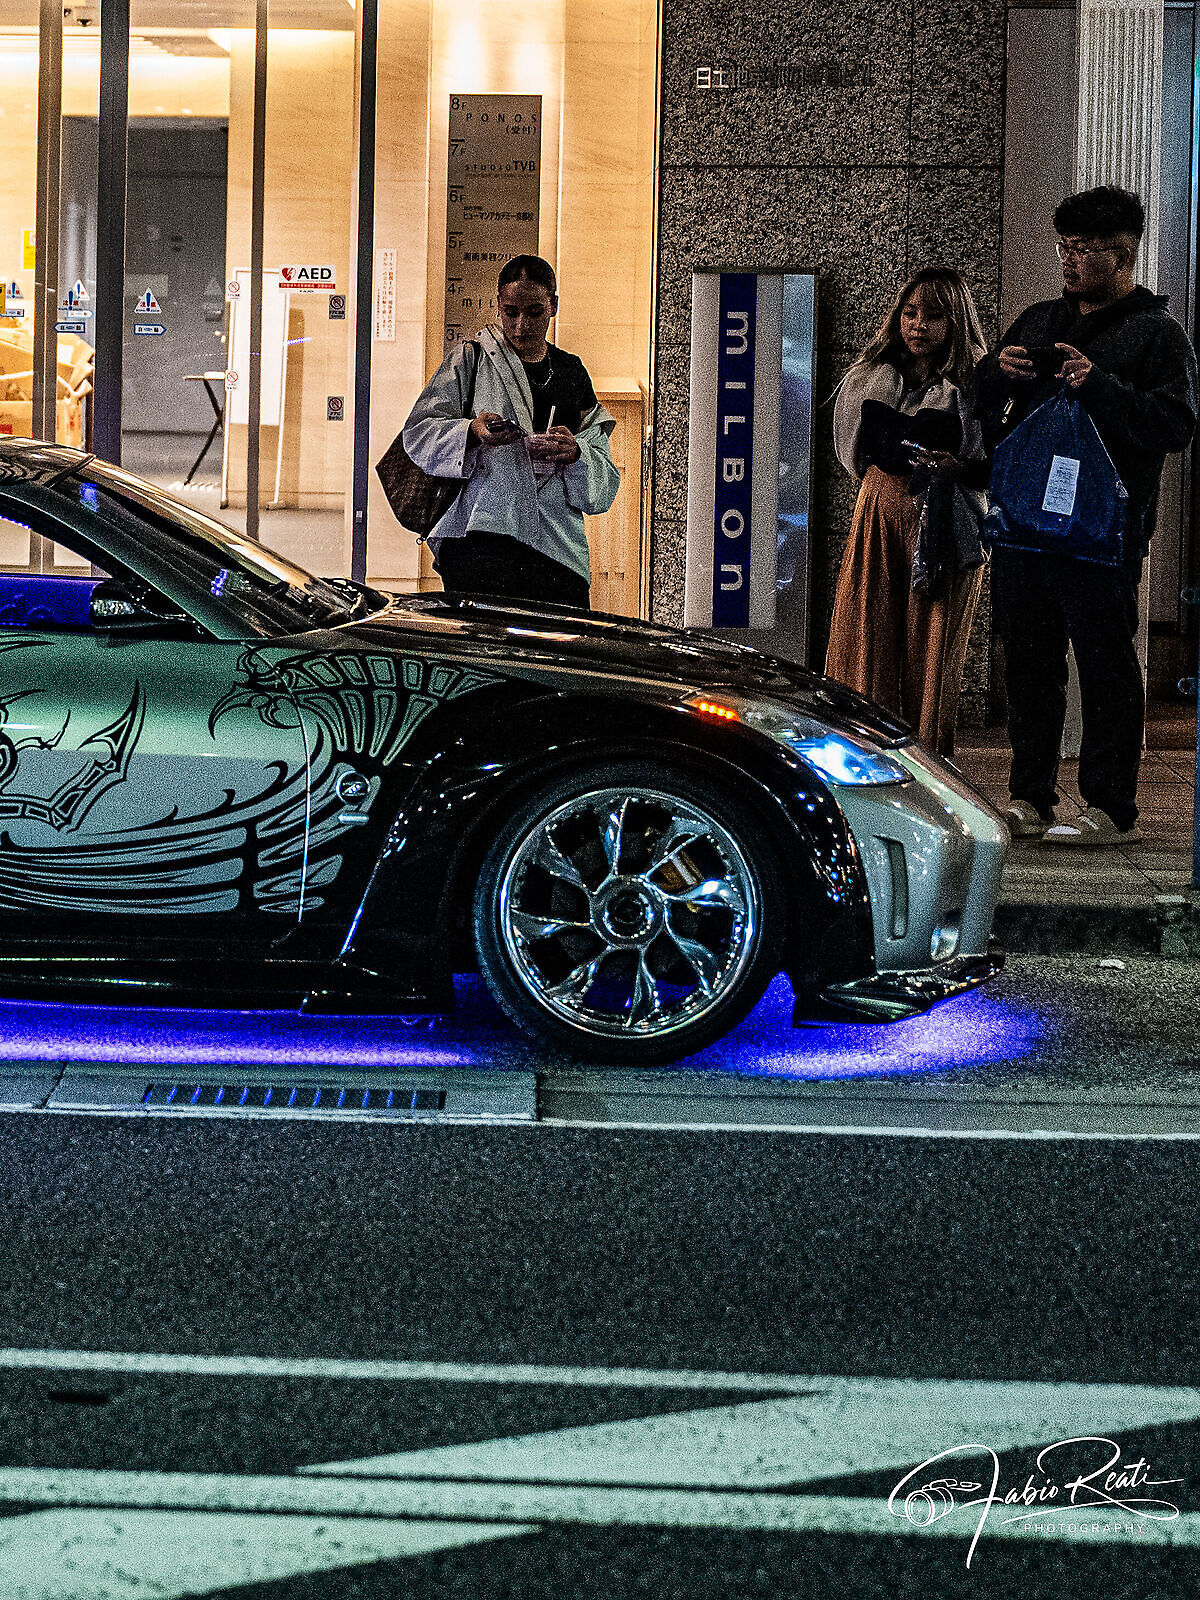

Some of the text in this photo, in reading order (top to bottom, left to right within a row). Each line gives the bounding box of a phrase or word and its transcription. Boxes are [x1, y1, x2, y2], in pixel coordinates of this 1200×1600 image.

[466, 113, 537, 122] PONOS
[513, 160, 536, 171] TVB
[297, 267, 332, 280] AED
